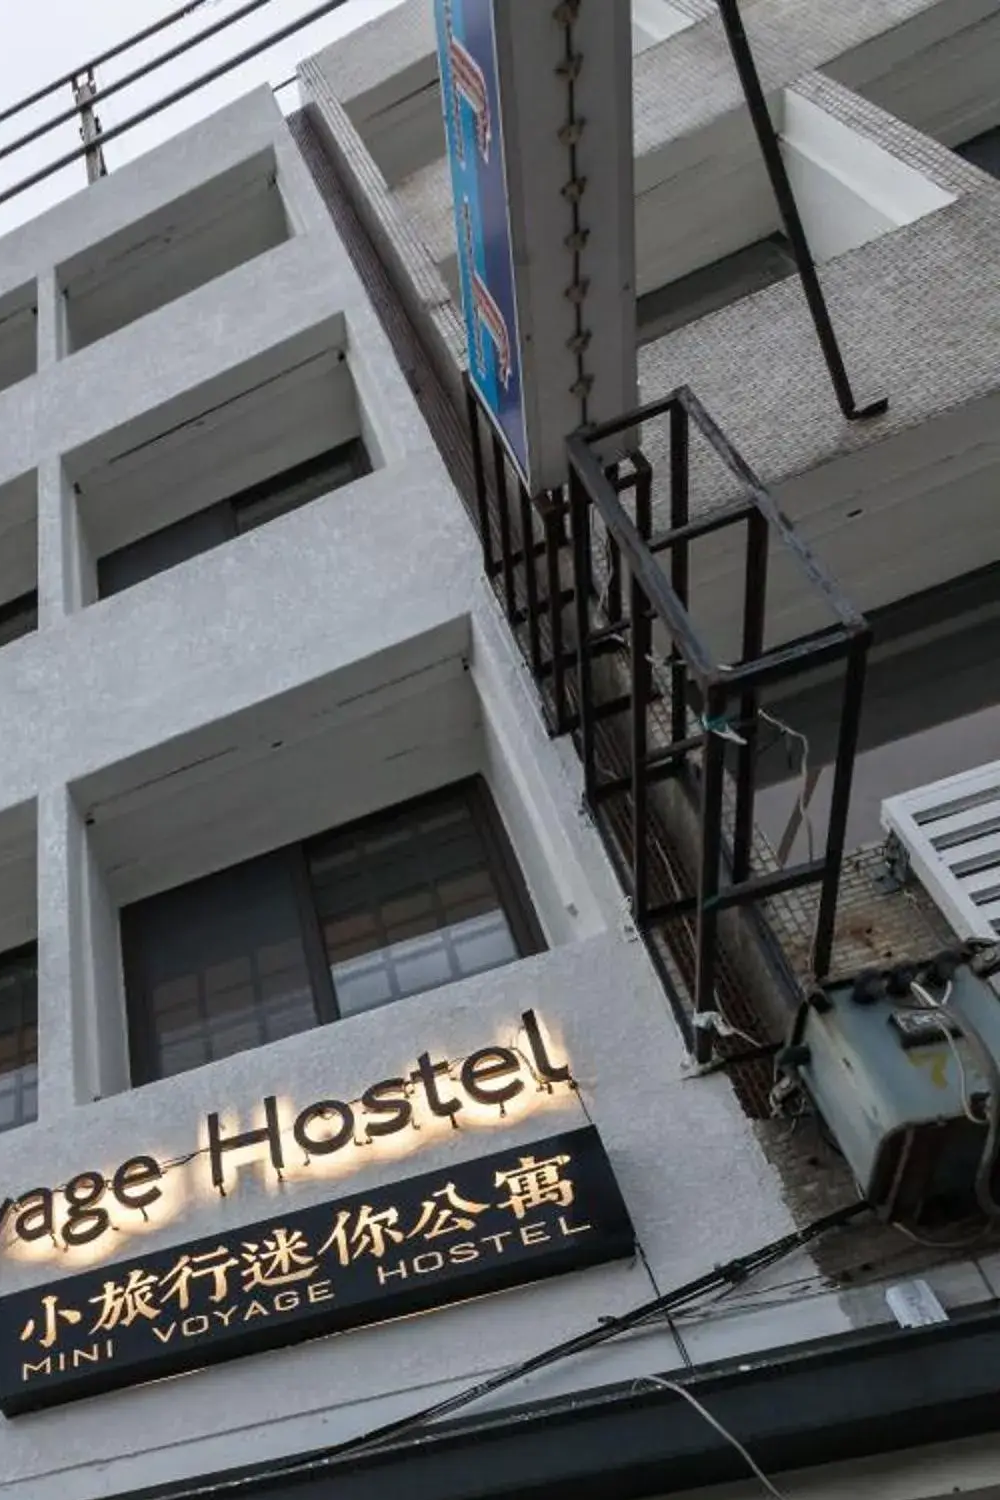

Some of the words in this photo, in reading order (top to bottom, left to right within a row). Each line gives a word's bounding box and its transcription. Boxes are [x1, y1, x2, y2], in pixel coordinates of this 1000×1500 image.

[207, 1008, 570, 1187] Hostel
[19, 1155, 576, 1348] 小旅行迷你公寓
[22, 1339, 114, 1381] MINI
[152, 1281, 334, 1343] VOYAGE
[377, 1217, 592, 1284] HOSTEL
